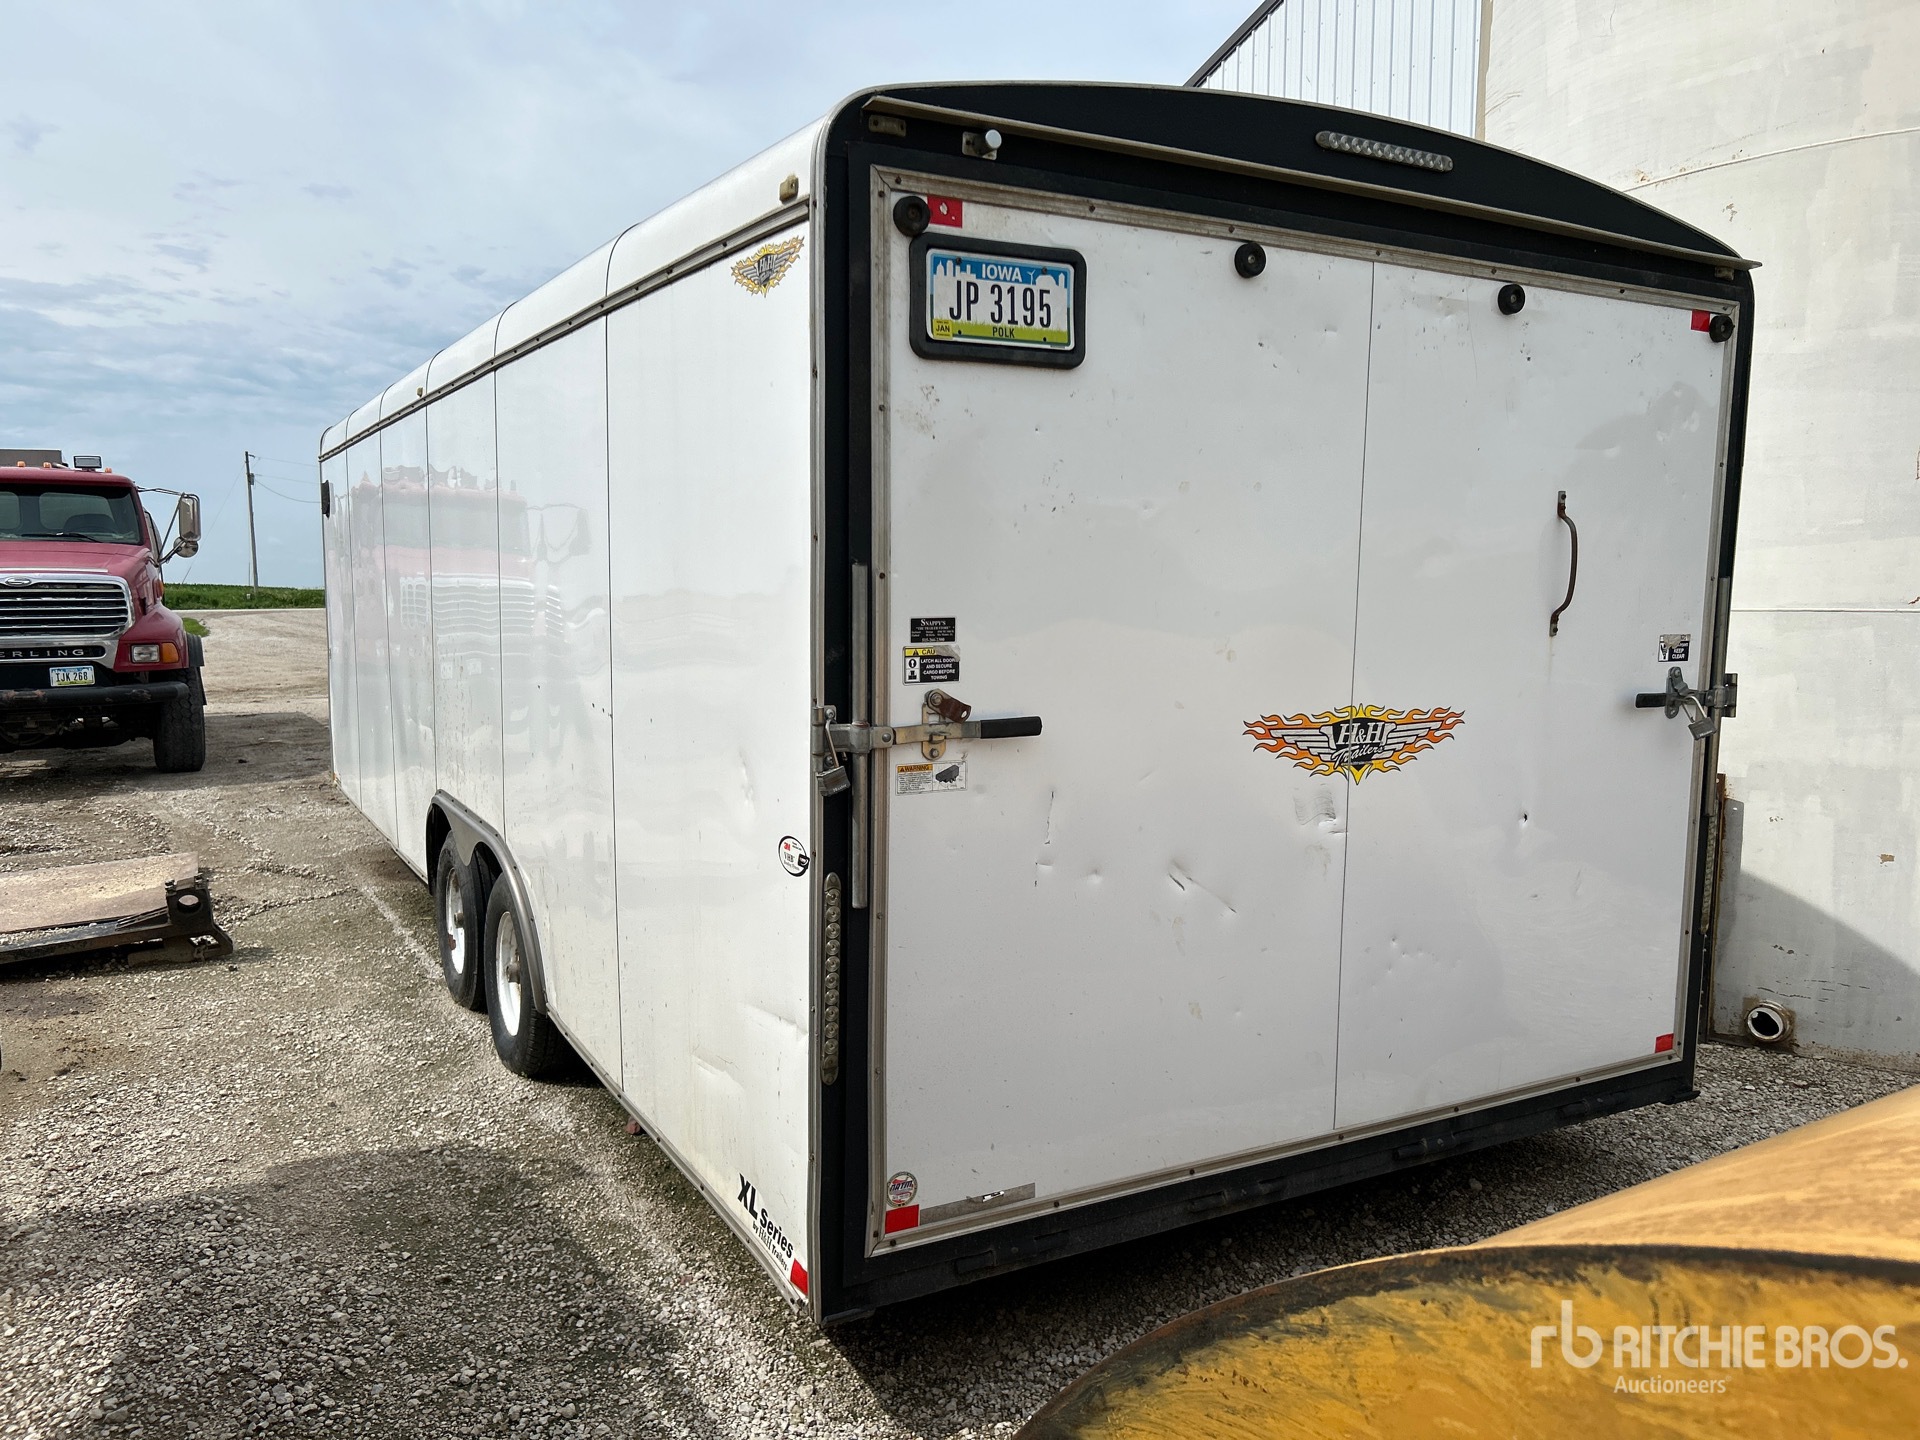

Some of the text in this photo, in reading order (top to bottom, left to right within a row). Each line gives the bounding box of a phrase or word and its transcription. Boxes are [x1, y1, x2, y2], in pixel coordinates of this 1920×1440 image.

[982, 264, 1022, 283] IOWA
[950, 280, 1051, 328] JP 3195
[936, 324, 950, 333] JAN
[992, 326, 1015, 338] POLK
[56, 671, 88, 682] IJK 268
[1336, 722, 1385, 745] H&H
[1331, 744, 1383, 769] Trailers
[905, 764, 929, 772] WARNING
[737, 1172, 794, 1259] XL Series
